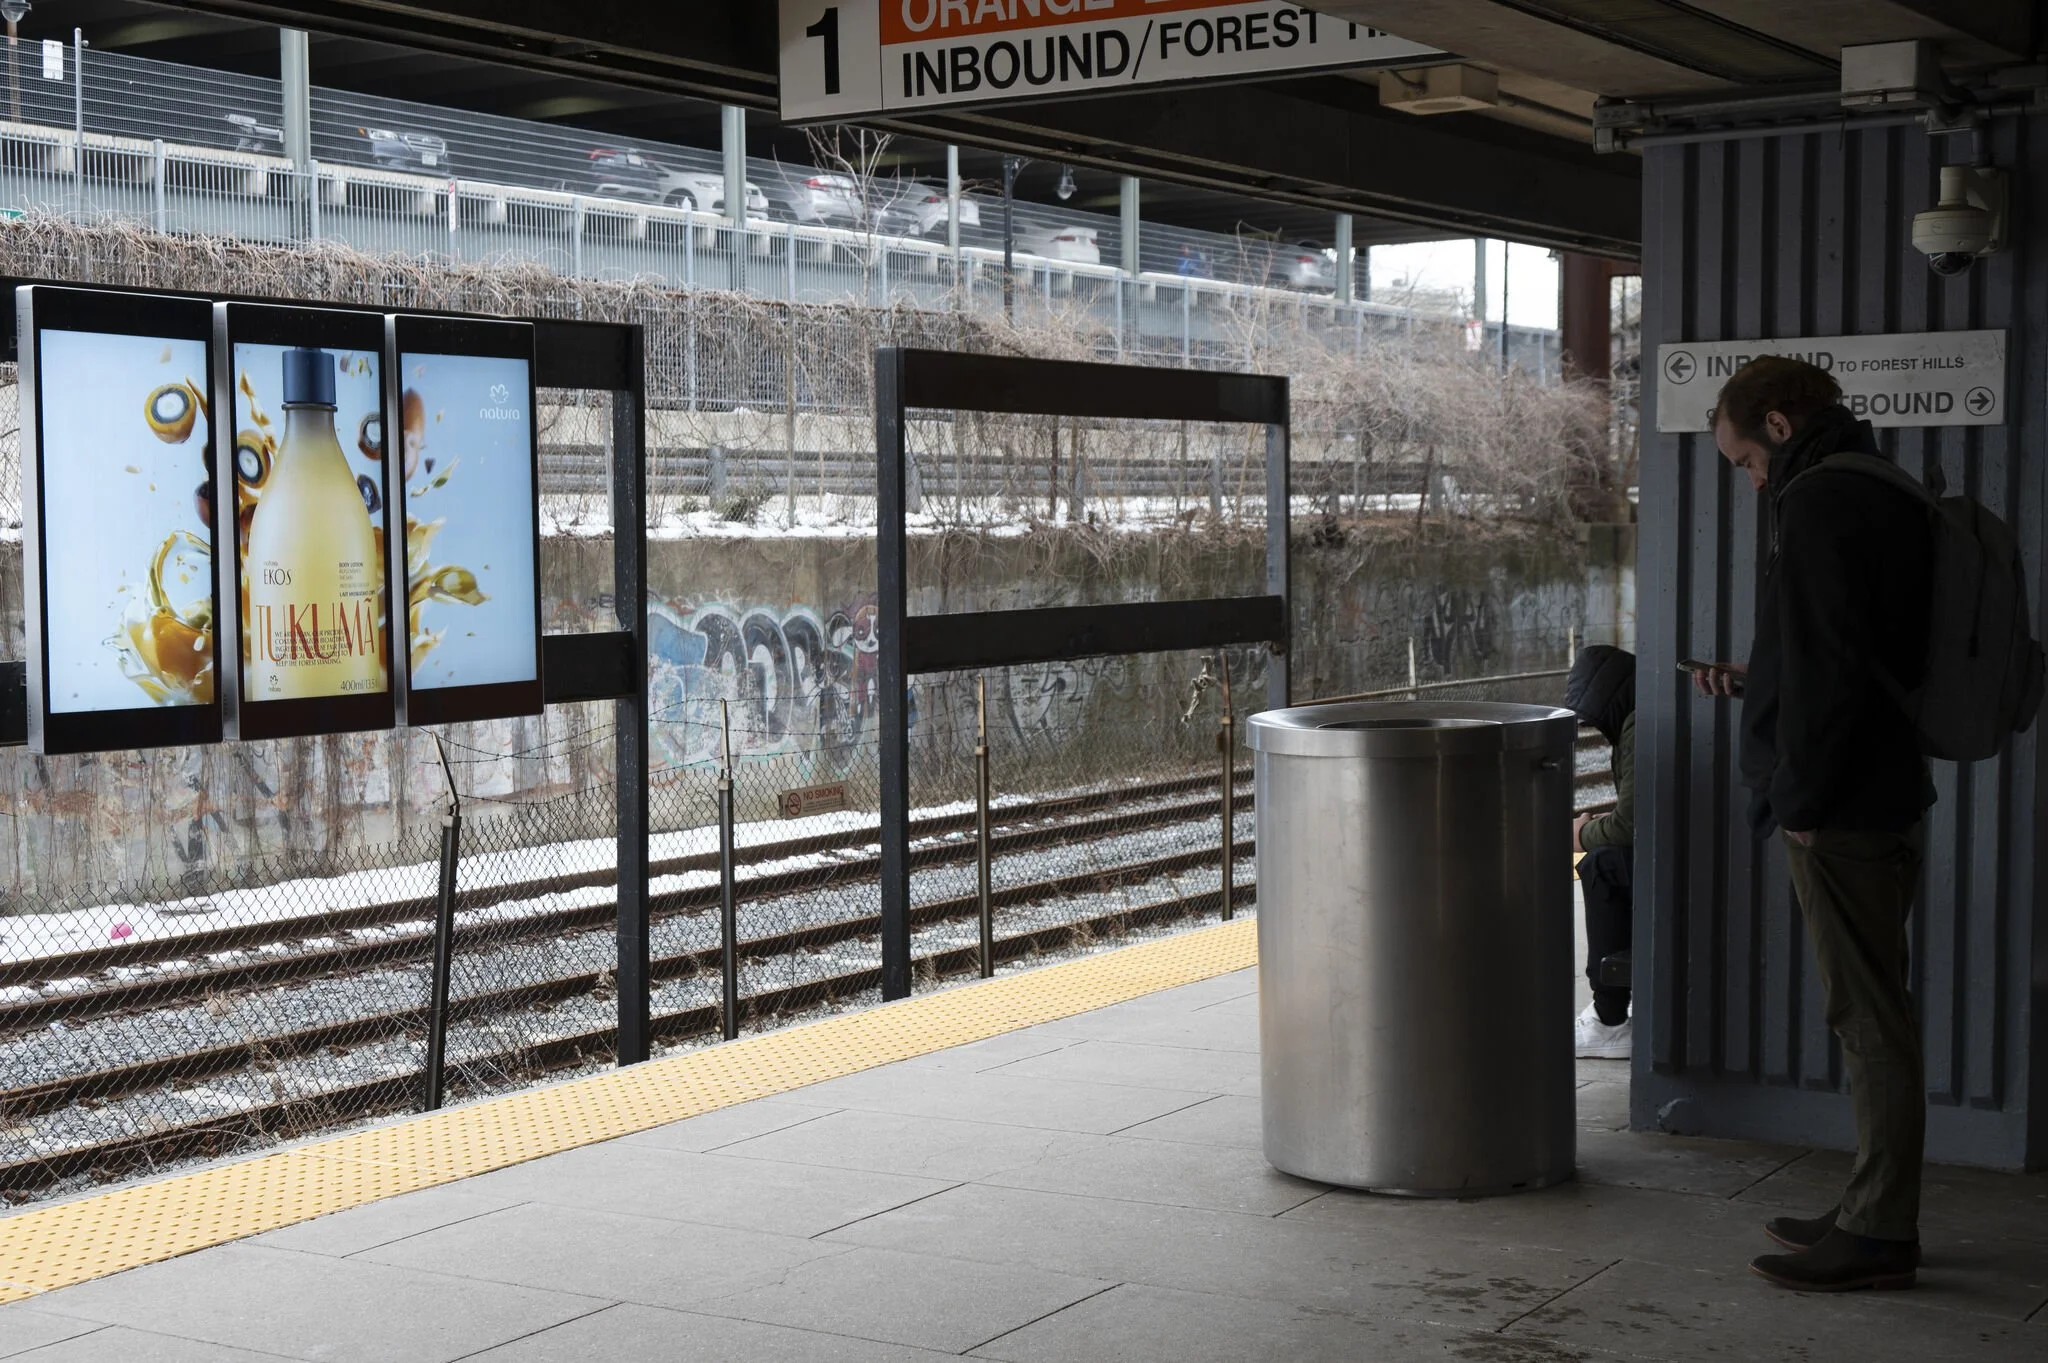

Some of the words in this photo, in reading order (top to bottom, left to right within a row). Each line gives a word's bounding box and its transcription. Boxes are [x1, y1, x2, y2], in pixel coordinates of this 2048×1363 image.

[806, 7, 842, 95] 1
[1838, 360, 1856, 373] TO
[1861, 358, 1918, 371] FOREST
[1922, 355, 1965, 370] HILLS
[480, 407, 520, 420] natura
[263, 568, 292, 585] EKOS
[803, 791, 814, 800] NO
[815, 785, 844, 799] SMOKING
